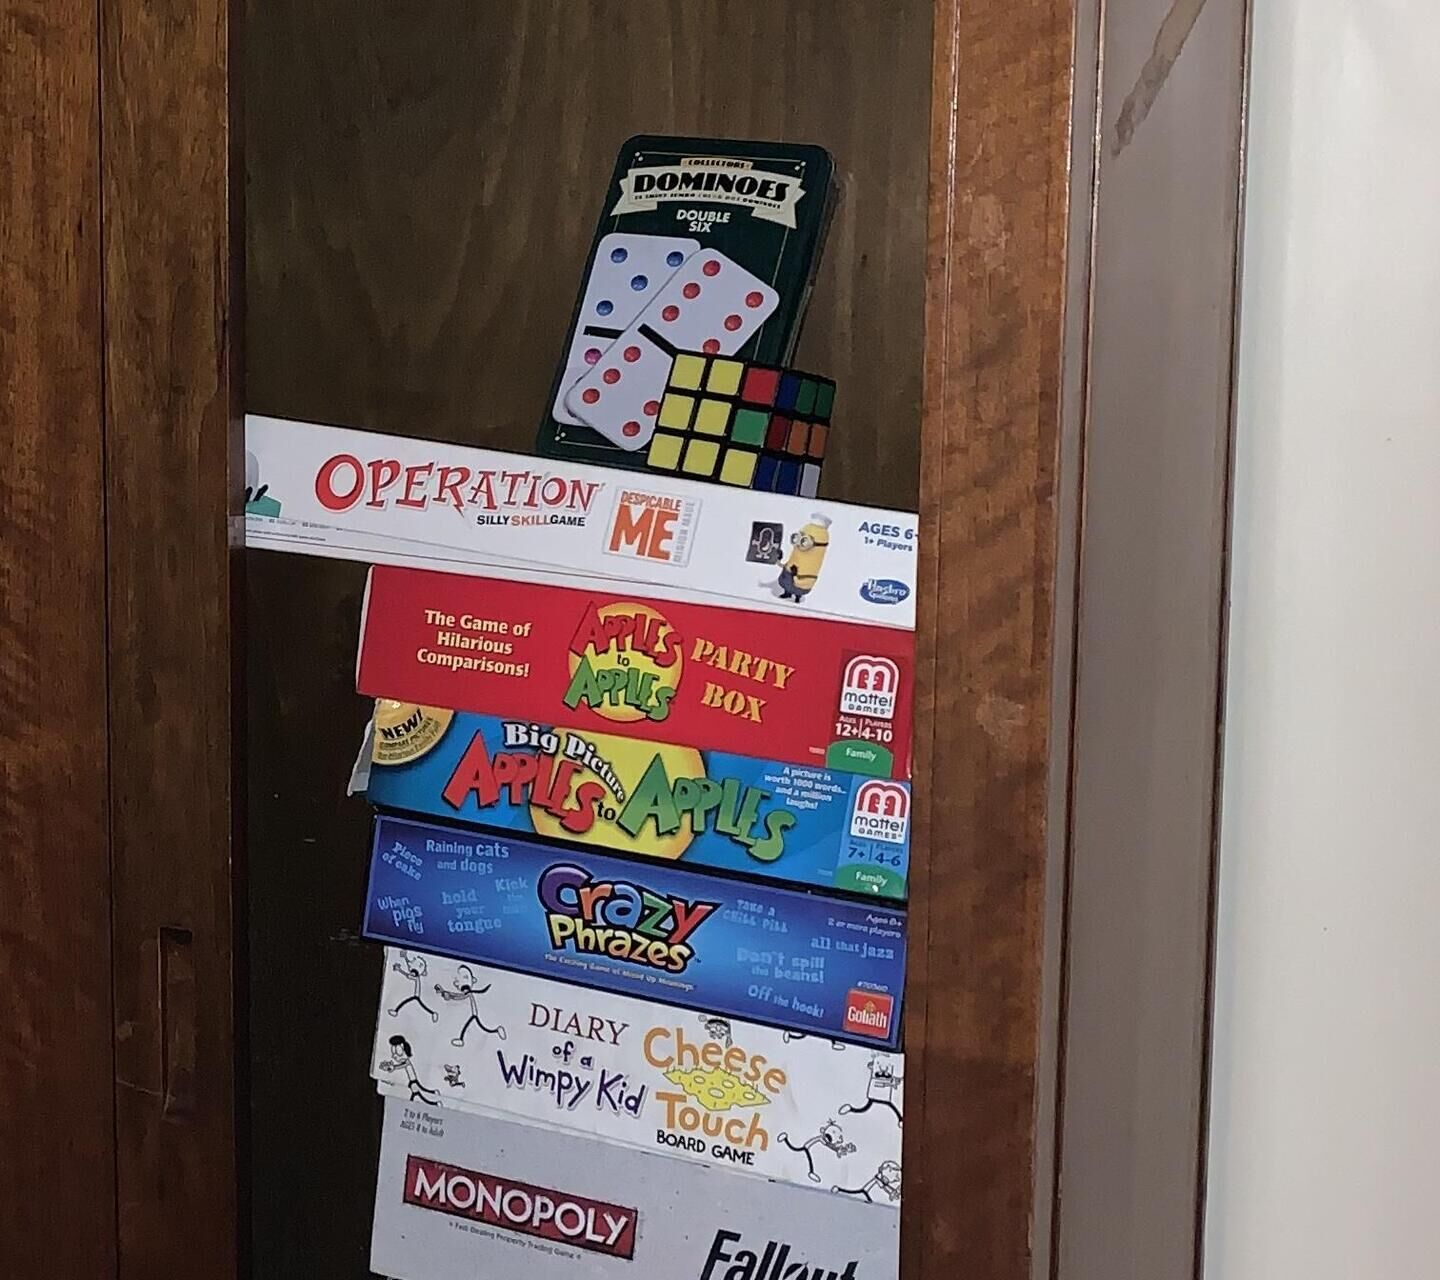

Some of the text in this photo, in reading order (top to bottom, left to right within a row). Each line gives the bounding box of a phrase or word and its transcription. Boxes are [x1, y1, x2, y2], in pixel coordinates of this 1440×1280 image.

[632, 171, 791, 203] DOMINOES
[675, 209, 731, 224] DOUBLE
[688, 221, 712, 233] SIX
[314, 452, 601, 518] OPERATION
[620, 489, 682, 512] DESPICABLE
[476, 514, 511, 526] SILLY
[858, 521, 901, 538] AGES
[609, 502, 680, 562] ME
[876, 539, 914, 552] Players
[861, 578, 909, 598] Hasbro
[424, 609, 532, 637] The Game of
[568, 600, 682, 669] APPLES
[436, 630, 513, 655] Hilarious
[416, 648, 530, 678] Comparisons!
[616, 652, 630, 667] to
[689, 636, 796, 690] PARTY
[562, 654, 677, 722] APPLES
[843, 690, 894, 708] mattel
[699, 681, 768, 724] BOX
[847, 703, 891, 716] GAMES
[379, 708, 424, 741] NEW!
[834, 722, 895, 744] 12+ 4-10
[502, 722, 560, 756] Big
[846, 747, 877, 762] Family
[563, 732, 627, 804] Picture
[791, 769, 823, 780] picture
[441, 728, 607, 834] APPLES
[764, 774, 813, 789] worth 1000
[775, 786, 833, 801] and million
[786, 797, 819, 810] laughs!
[596, 801, 616, 821] to
[615, 752, 798, 863] APPLES
[854, 815, 906, 833] mattel
[857, 827, 900, 840] GAMES
[426, 839, 510, 859] Raining cats
[847, 846, 902, 867] 7+ 4-6
[437, 858, 493, 876] and dogs
[855, 870, 888, 887] Family
[495, 876, 529, 893] Kick
[377, 894, 411, 911] When
[441, 889, 479, 906] hold
[538, 863, 720, 944] Crazy
[392, 907, 423, 928] pigs
[446, 917, 503, 934] tongue
[548, 913, 693, 973] Phrazes
[811, 936, 894, 960] all that jazz
[736, 946, 826, 970] Don't spill
[774, 966, 825, 984] beans!
[747, 984, 825, 1019] Off hook!
[527, 1002, 630, 1047] DIARY
[847, 1006, 888, 1029] Goliath
[551, 1040, 593, 1067] of a
[642, 1026, 788, 1094] Cheese
[496, 1049, 647, 1116] Wimpy Kid
[655, 1091, 769, 1152] Touch
[656, 1129, 756, 1166] BOARD GAME
[413, 1167, 629, 1247] MONOPOLY
